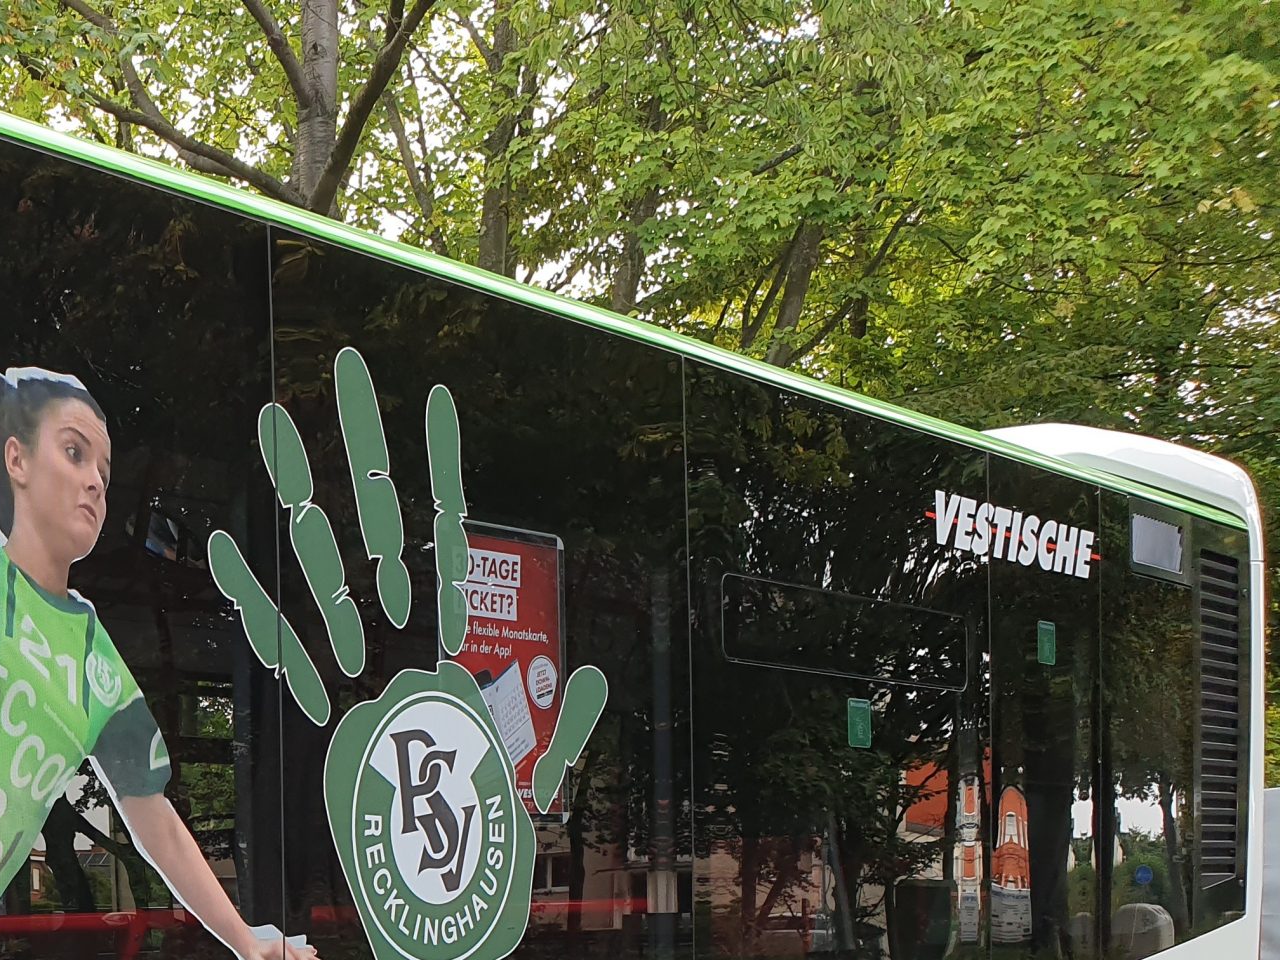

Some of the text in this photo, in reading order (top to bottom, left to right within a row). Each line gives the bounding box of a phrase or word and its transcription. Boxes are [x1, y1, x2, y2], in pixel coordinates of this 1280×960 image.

[934, 490, 1095, 579] VESTISCHE
[462, 588, 513, 615] ICKET?
[473, 621, 500, 637] flexible
[501, 626, 549, 644] Monatskarte,
[471, 640, 478, 652] in
[480, 641, 492, 654] der
[493, 644, 512, 659] App!
[361, 795, 505, 946] RECKLINGHAUSEN
